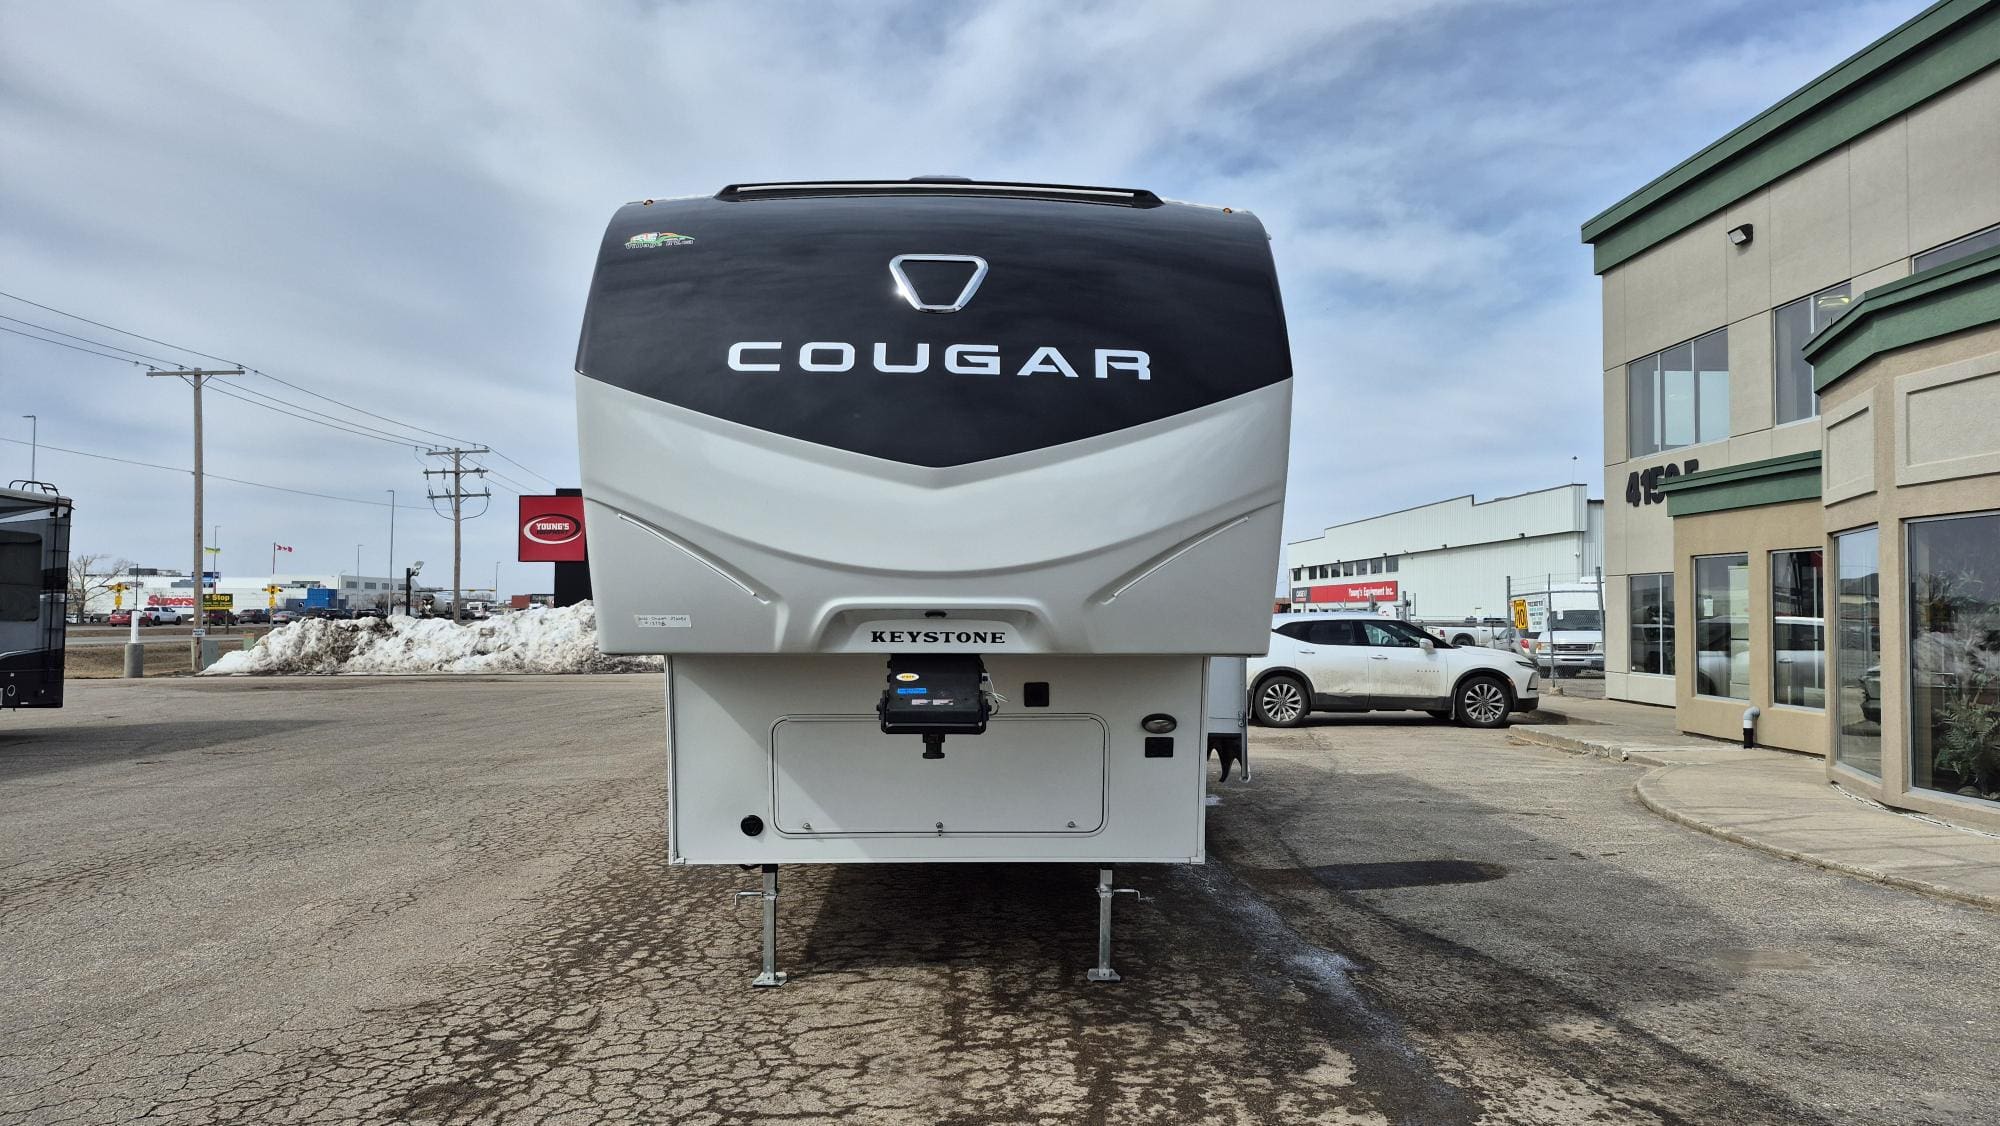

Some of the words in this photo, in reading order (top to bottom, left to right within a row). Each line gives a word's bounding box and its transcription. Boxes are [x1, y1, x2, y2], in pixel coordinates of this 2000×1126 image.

[727, 341, 1151, 380] COUGAR
[536, 523, 570, 531] YOUNG'S
[212, 594, 230, 602] Stop
[871, 631, 1006, 644] KEYSTONE
